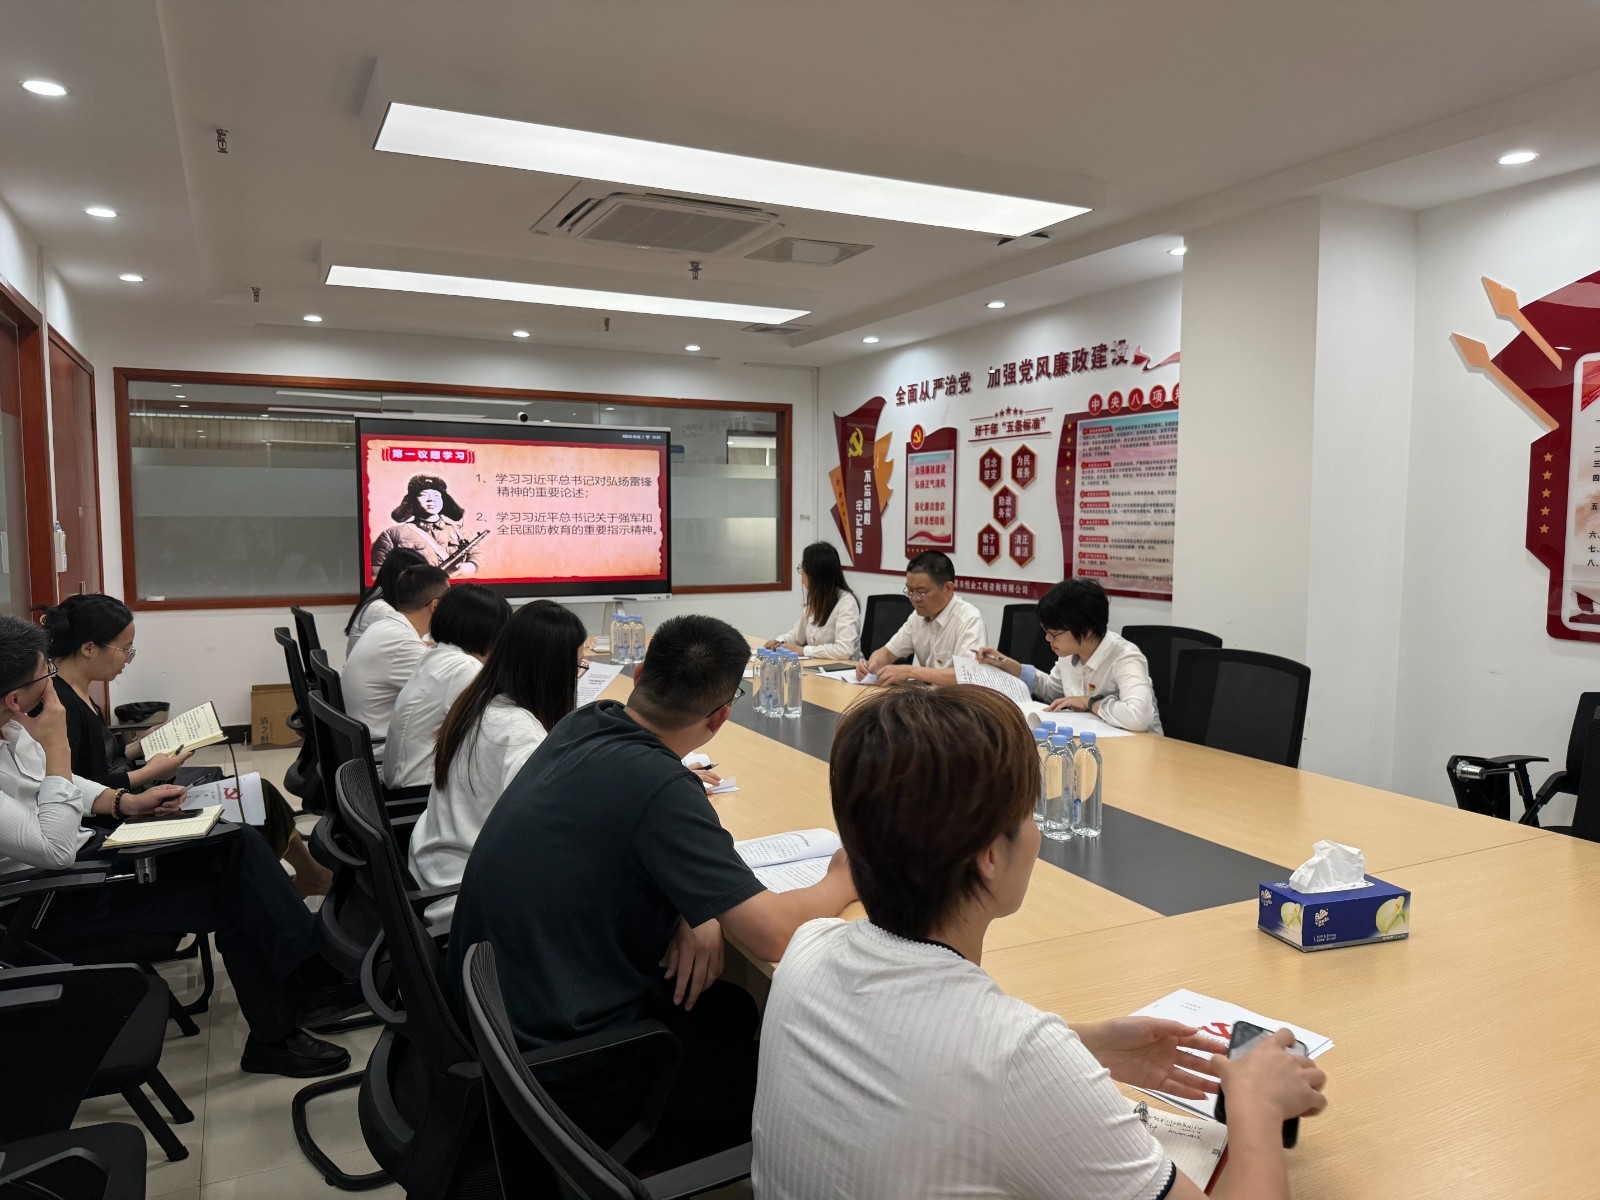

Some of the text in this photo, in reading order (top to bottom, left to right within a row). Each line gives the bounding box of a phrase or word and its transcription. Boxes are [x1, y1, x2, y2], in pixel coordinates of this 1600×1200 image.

[895, 339, 1129, 407] 全面从严治党 加强党风廉政建设
[392, 448, 465, 461] 第一议题学习
